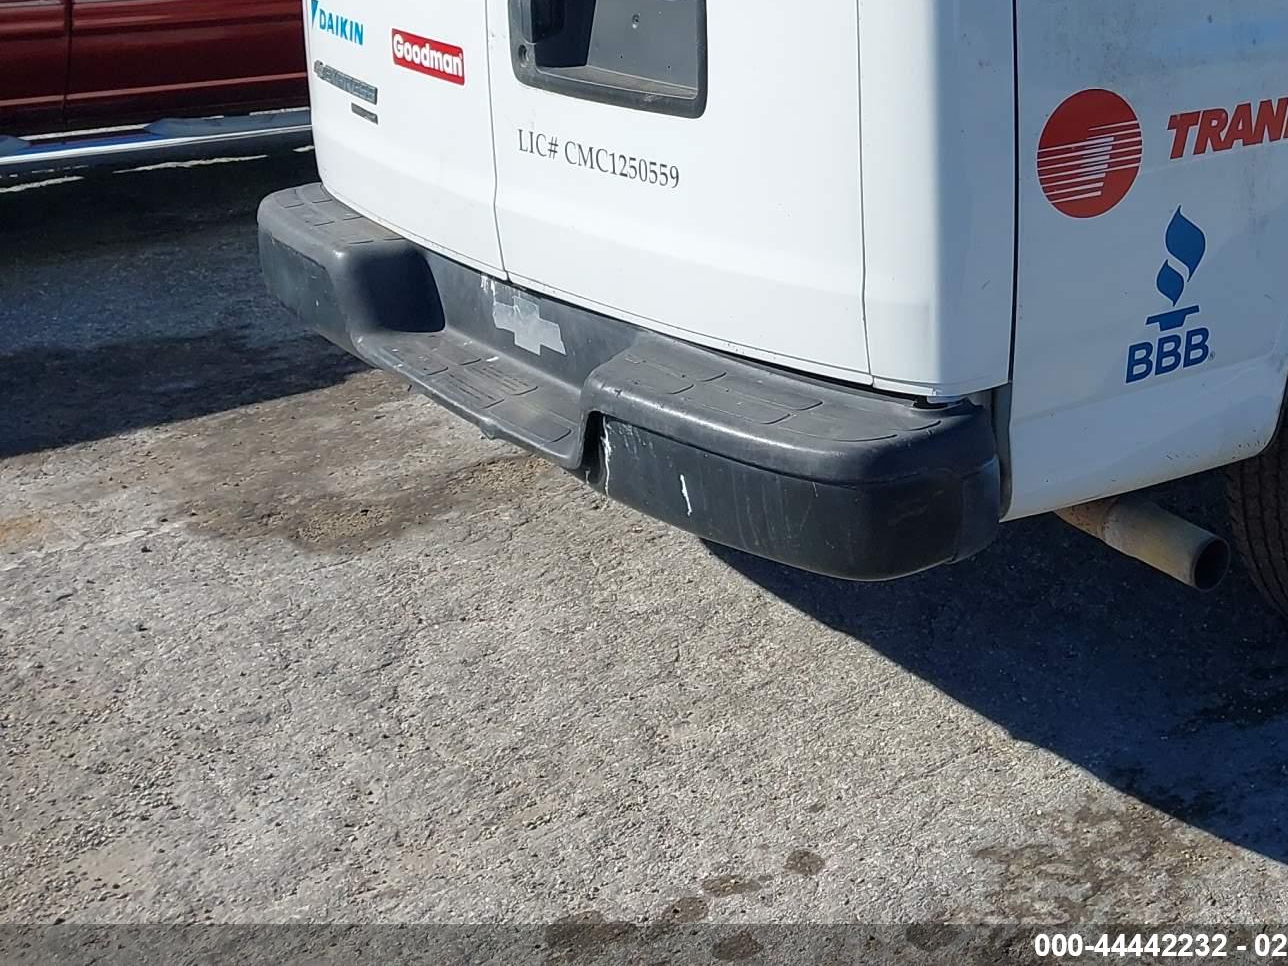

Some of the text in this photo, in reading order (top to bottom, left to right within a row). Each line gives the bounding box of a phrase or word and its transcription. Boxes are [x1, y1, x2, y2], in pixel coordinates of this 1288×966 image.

[319, 7, 364, 46] DAIKIN
[392, 33, 463, 78] Goodman
[518, 127, 680, 189] LIC# CMC1250559
[1125, 327, 1210, 384] BBB
